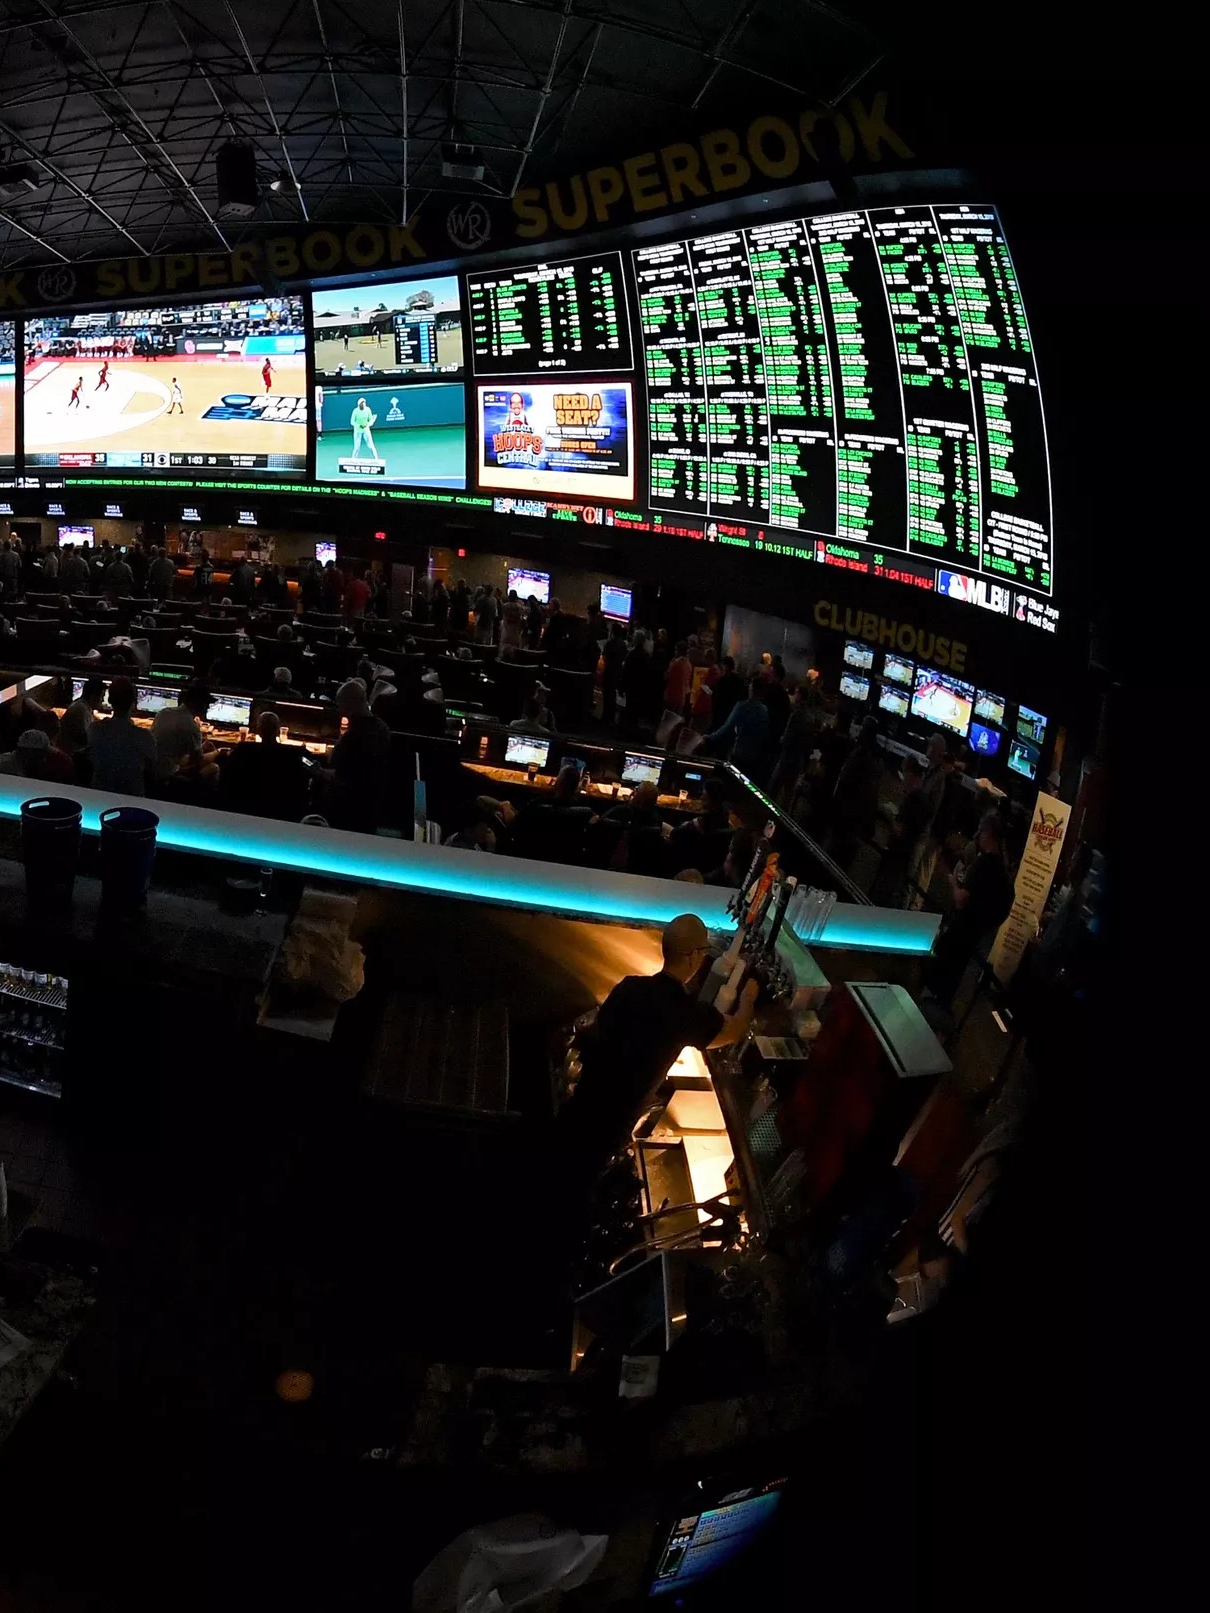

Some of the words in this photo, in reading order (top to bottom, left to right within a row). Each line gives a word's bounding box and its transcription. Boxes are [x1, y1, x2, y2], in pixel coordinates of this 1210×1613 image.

[512, 91, 917, 238] SUPERBOOK
[95, 215, 428, 297] SUPERBOOK
[553, 393, 589, 411] NEED
[591, 393, 603, 410] A
[556, 410, 600, 427] SEAT?
[492, 433, 543, 456] HOOPS
[95, 453, 105, 462] 35
[143, 454, 152, 462] 31
[187, 455, 204, 464] 1:03
[614, 510, 642, 522] Oklahoma
[654, 515, 662, 524] 35
[718, 534, 750, 548] Tennessee
[755, 539, 763, 549] 19
[782, 545, 795, 556] 1ST
[795, 548, 813, 560] HALF
[826, 544, 860, 560] Oklahoma
[873, 553, 884, 565] 35
[825, 555, 847, 568] Rhode
[848, 559, 868, 573] Island
[874, 565, 883, 576] 31
[900, 572, 914, 584] 1ST
[915, 576, 934, 590] HALF
[967, 577, 1003, 613] MLB
[1028, 598, 1044, 613] Blue
[1027, 611, 1042, 627] Red
[1042, 617, 1056, 633] Sox
[813, 599, 968, 674] CLUBHOUSE
[1032, 822, 1064, 840] BASEBALL
